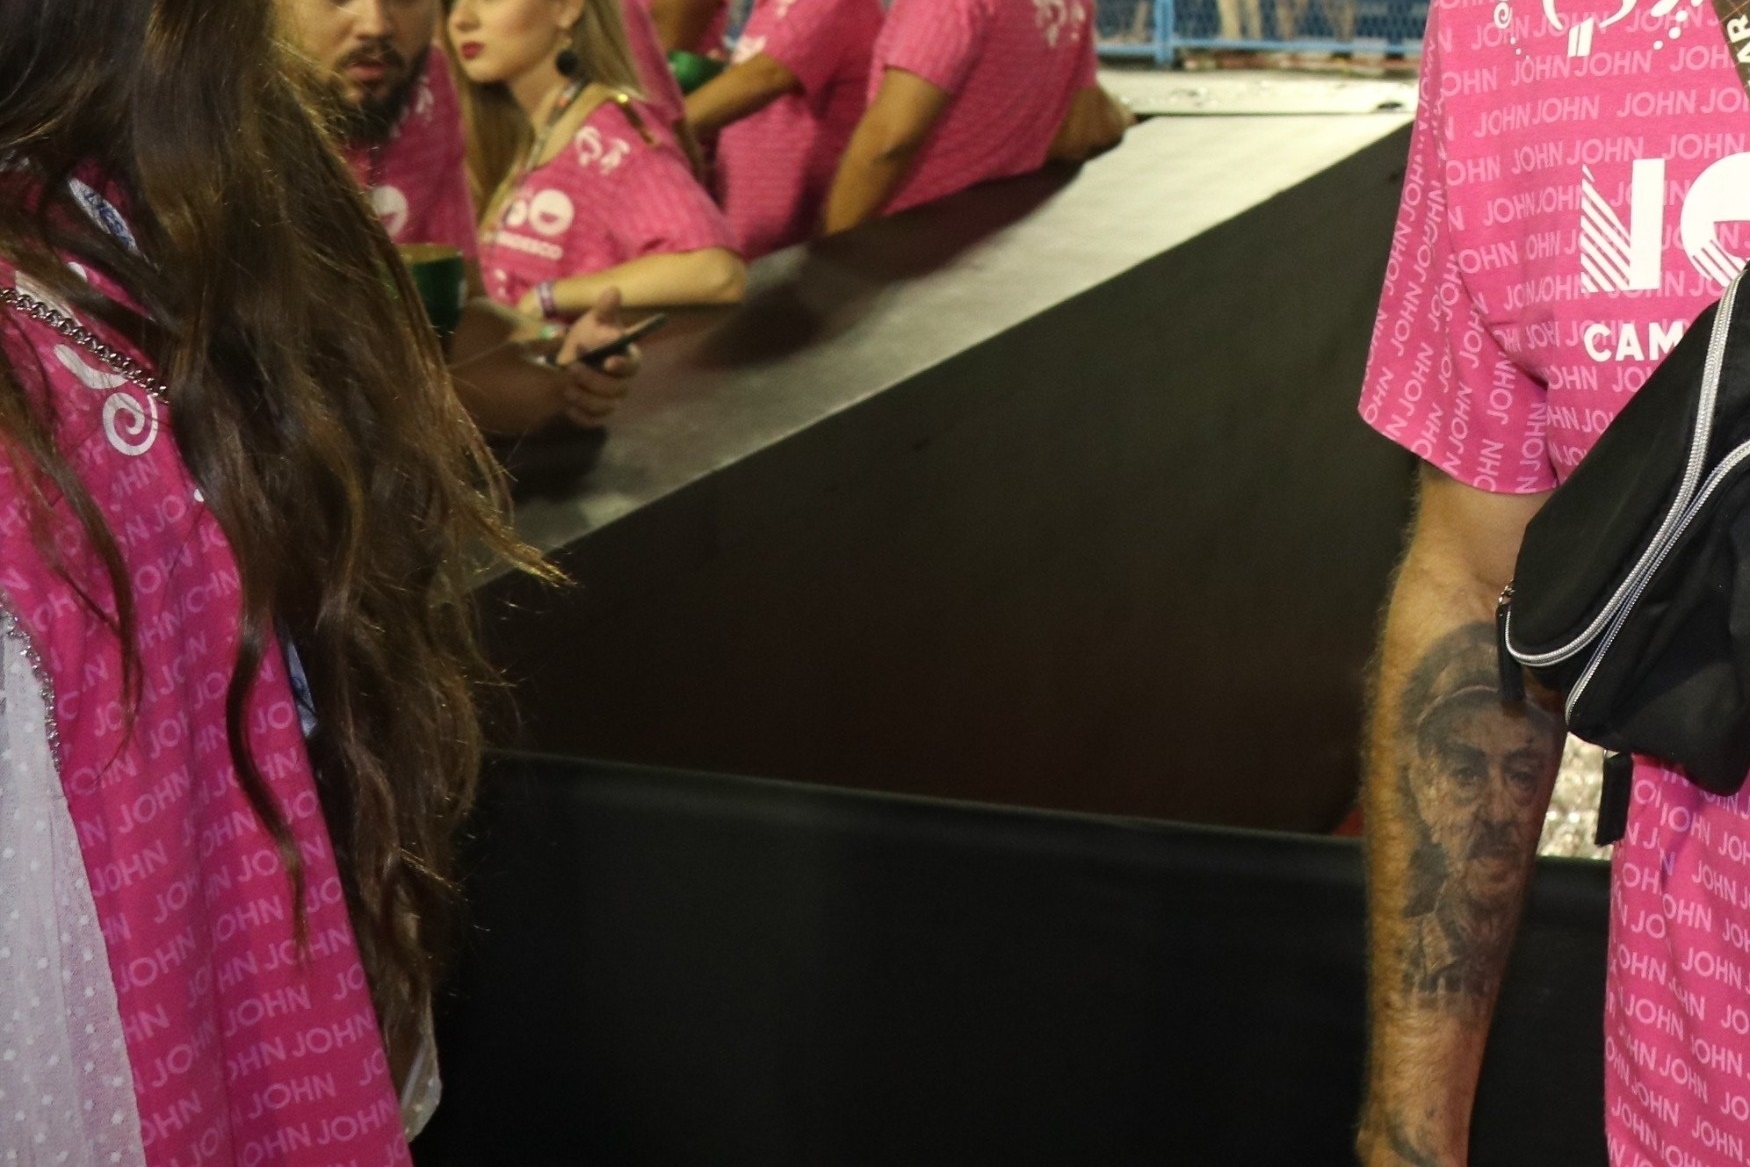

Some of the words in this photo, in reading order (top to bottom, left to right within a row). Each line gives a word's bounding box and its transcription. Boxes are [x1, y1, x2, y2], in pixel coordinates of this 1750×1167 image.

[1511, 55, 1570, 86] JOHN
[1574, 51, 1651, 77] JOHN
[1532, 95, 1600, 125] JOHN
[1616, 91, 1696, 118] JOHN
[1567, 137, 1643, 164] JOHN
[1397, 342, 1435, 417] JOHN
[1487, 352, 1516, 425] JOHN
[118, 764, 191, 834] JOHN
[117, 927, 196, 994] JOHN
[226, 984, 311, 1037] JOHN
[249, 1072, 336, 1120] JOHN
[316, 1091, 396, 1144] JOHN
